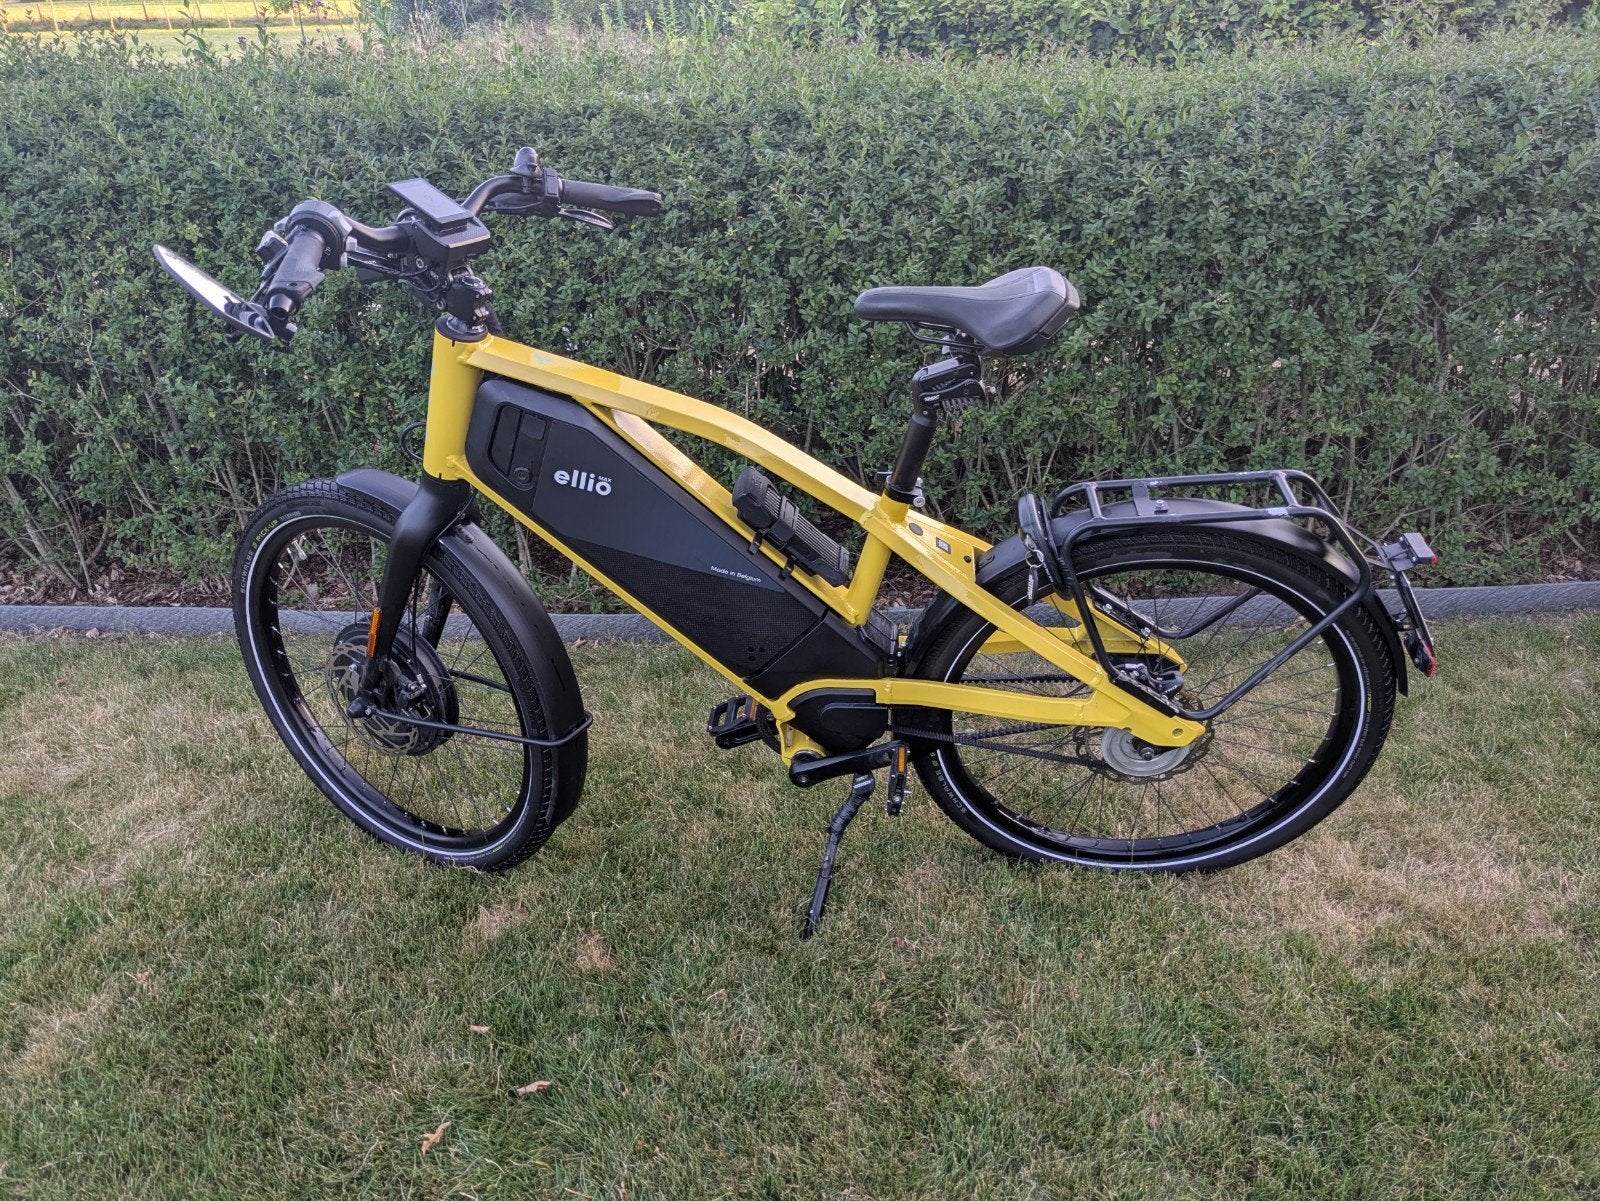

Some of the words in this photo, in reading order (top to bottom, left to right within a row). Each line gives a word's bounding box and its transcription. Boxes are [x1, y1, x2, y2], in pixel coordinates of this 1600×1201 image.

[553, 469, 612, 496] ellio
[598, 475, 613, 483] MAX
[240, 549, 255, 595] SCHWALBE
[255, 519, 279, 542] PICK-UP
[710, 565, 729, 575] Made
[736, 572, 762, 583] Belgium
